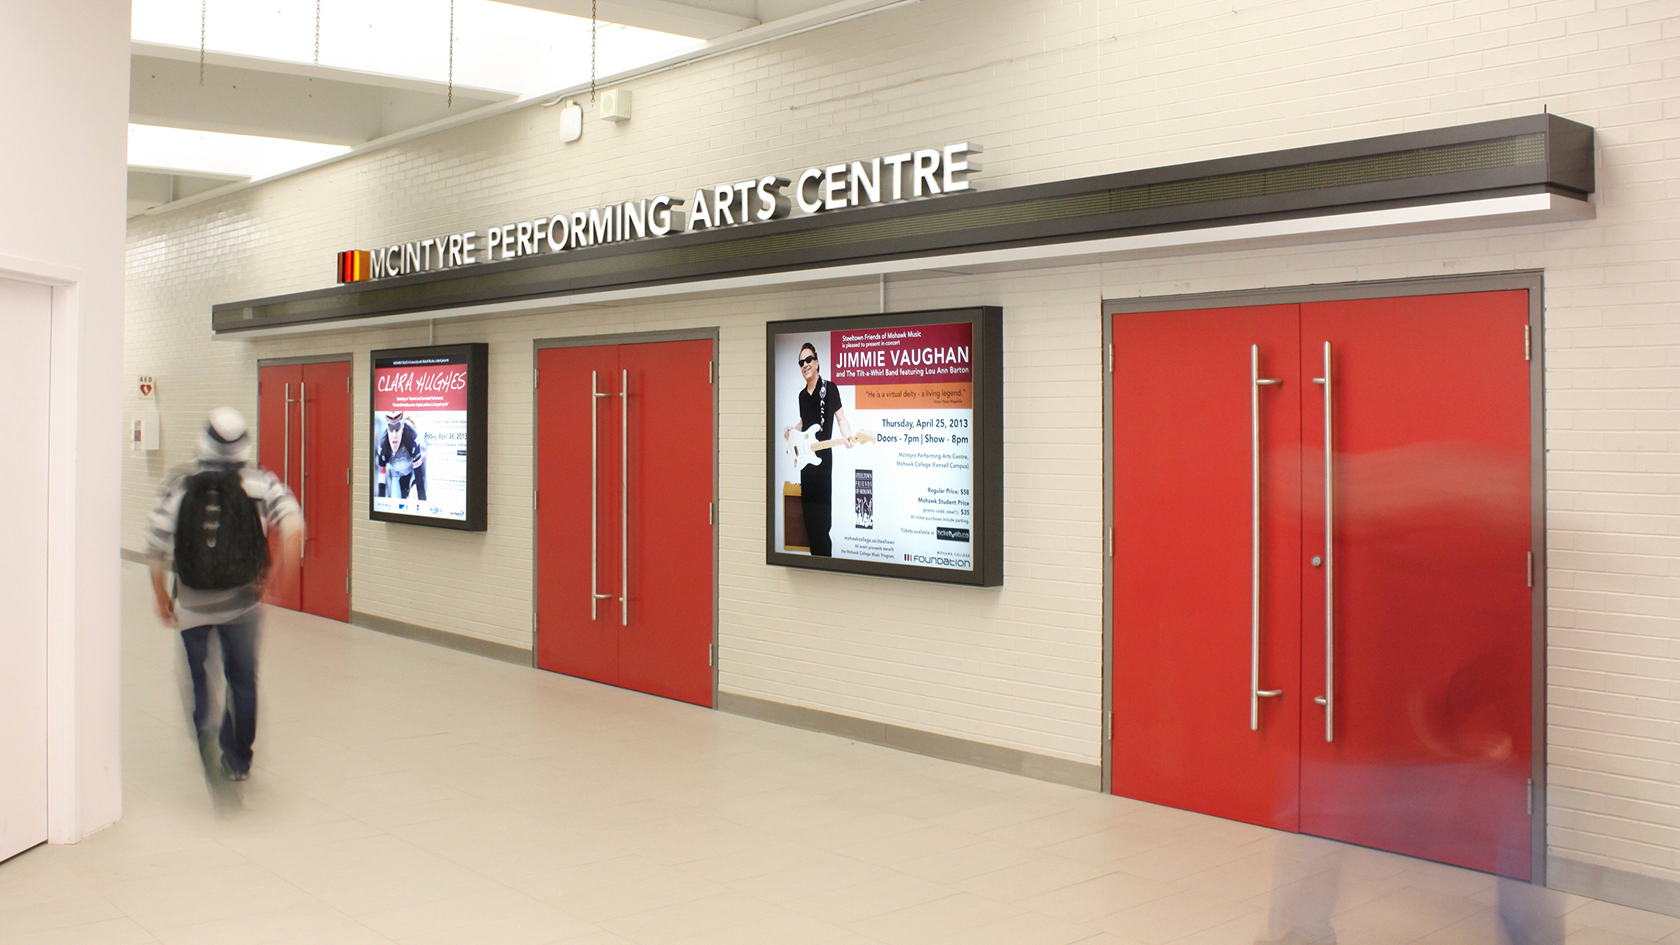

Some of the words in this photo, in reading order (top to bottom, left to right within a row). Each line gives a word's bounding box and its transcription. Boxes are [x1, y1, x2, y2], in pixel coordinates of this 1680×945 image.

[370, 231, 477, 280] MCINTYRE
[488, 195, 671, 261] PERFORMING
[688, 175, 777, 230] ARTS
[796, 142, 969, 214] CENTRE
[864, 333, 880, 341] Friends
[836, 350, 886, 368] JIMMIE
[890, 346, 969, 366] VAUGHAN
[836, 370, 846, 378] and
[856, 368, 884, 376] Tilt-a-Whirl
[886, 368, 898, 376] Band
[900, 367, 924, 377] featuring
[936, 366, 948, 374] Ann
[950, 366, 970, 374] Barton
[378, 372, 414, 393] CLARA
[416, 370, 467, 394] HUGHES
[902, 390, 917, 399] deity
[926, 390, 940, 398] living
[882, 418, 914, 430] Thursday,
[916, 418, 934, 430] April
[936, 418, 948, 429] 25,
[950, 418, 968, 428] 2013
[877, 434, 898, 442] Doors
[904, 434, 920, 444] 7pm
[924, 434, 945, 443] Show
[952, 434, 968, 445] 8pm
[898, 452, 916, 460] McIntyre
[928, 487, 945, 495] Regular
